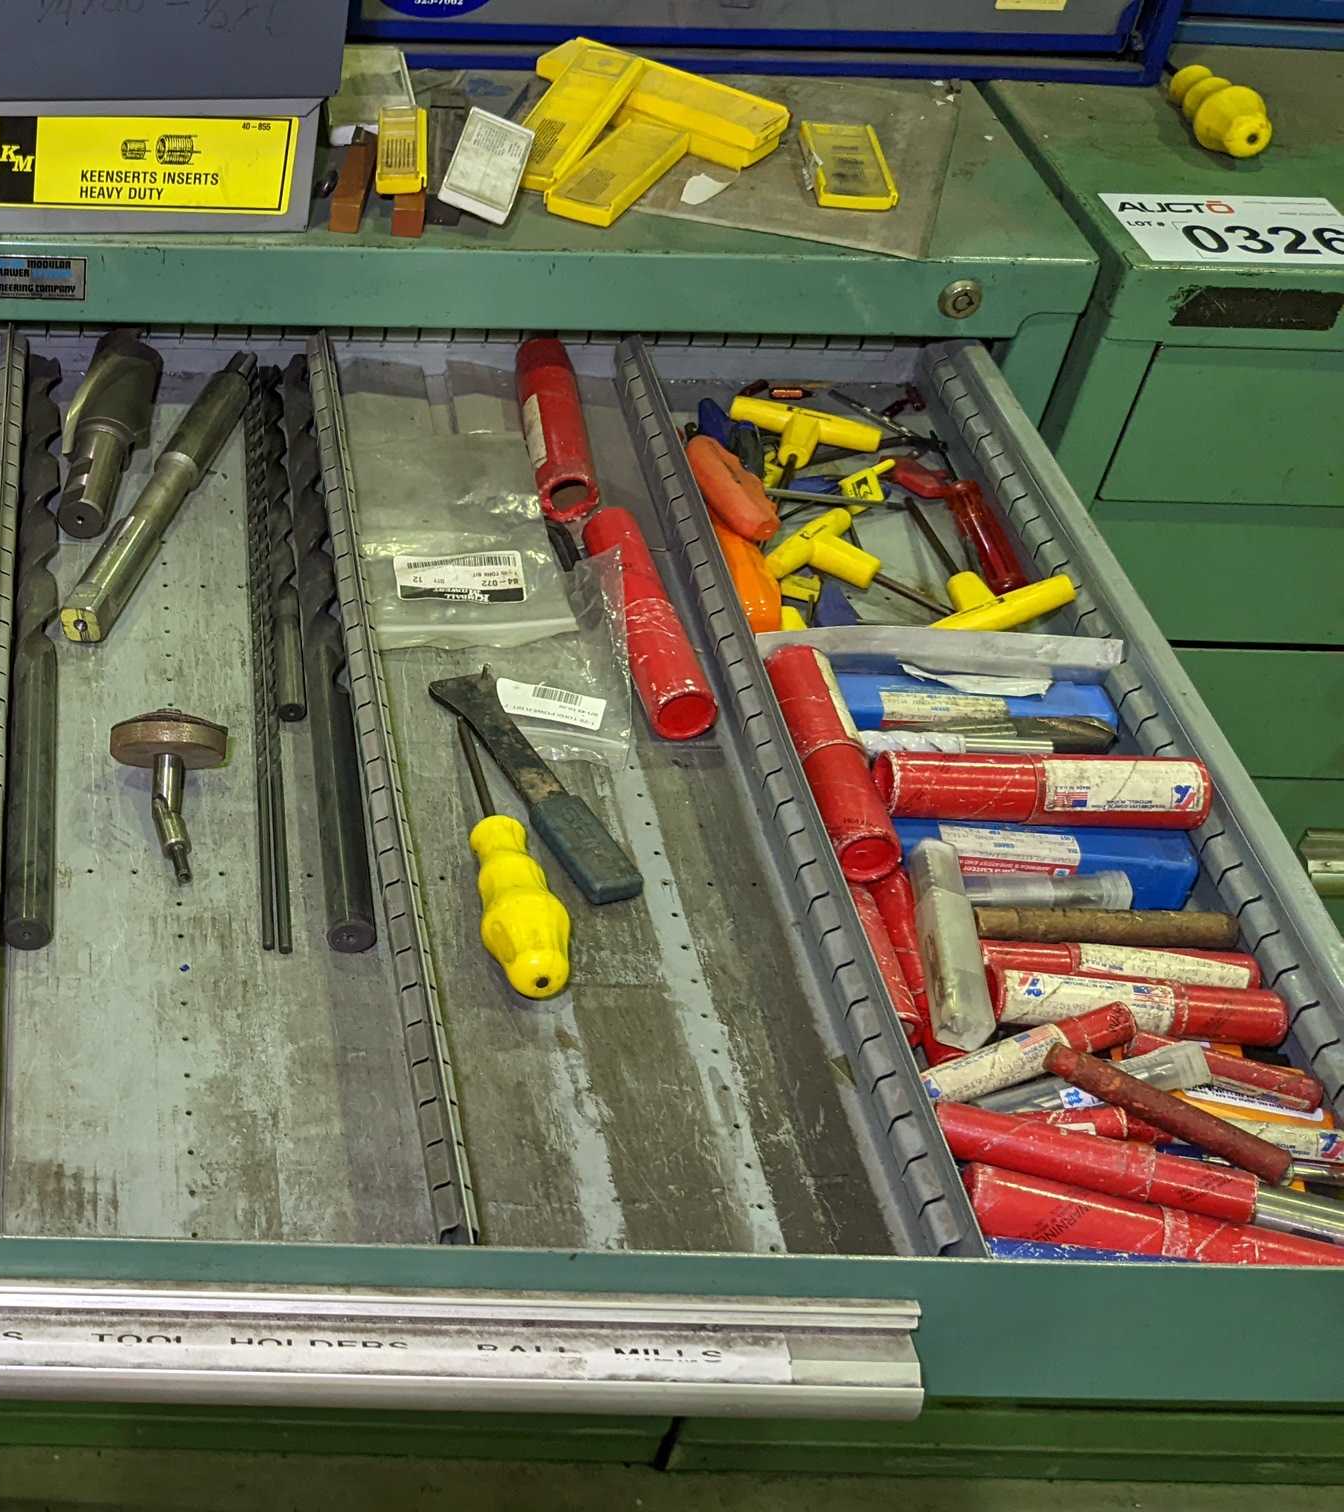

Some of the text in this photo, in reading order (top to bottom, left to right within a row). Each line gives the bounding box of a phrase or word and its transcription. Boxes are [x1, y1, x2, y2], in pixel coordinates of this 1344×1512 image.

[80, 169, 219, 186] KEENSERTS INSERTS
[79, 186, 164, 201] HEAVY DUTY
[1181, 225, 1344, 255] 0326
[36, 284, 76, 293] COMPANY
[412, 575, 423, 583] 12
